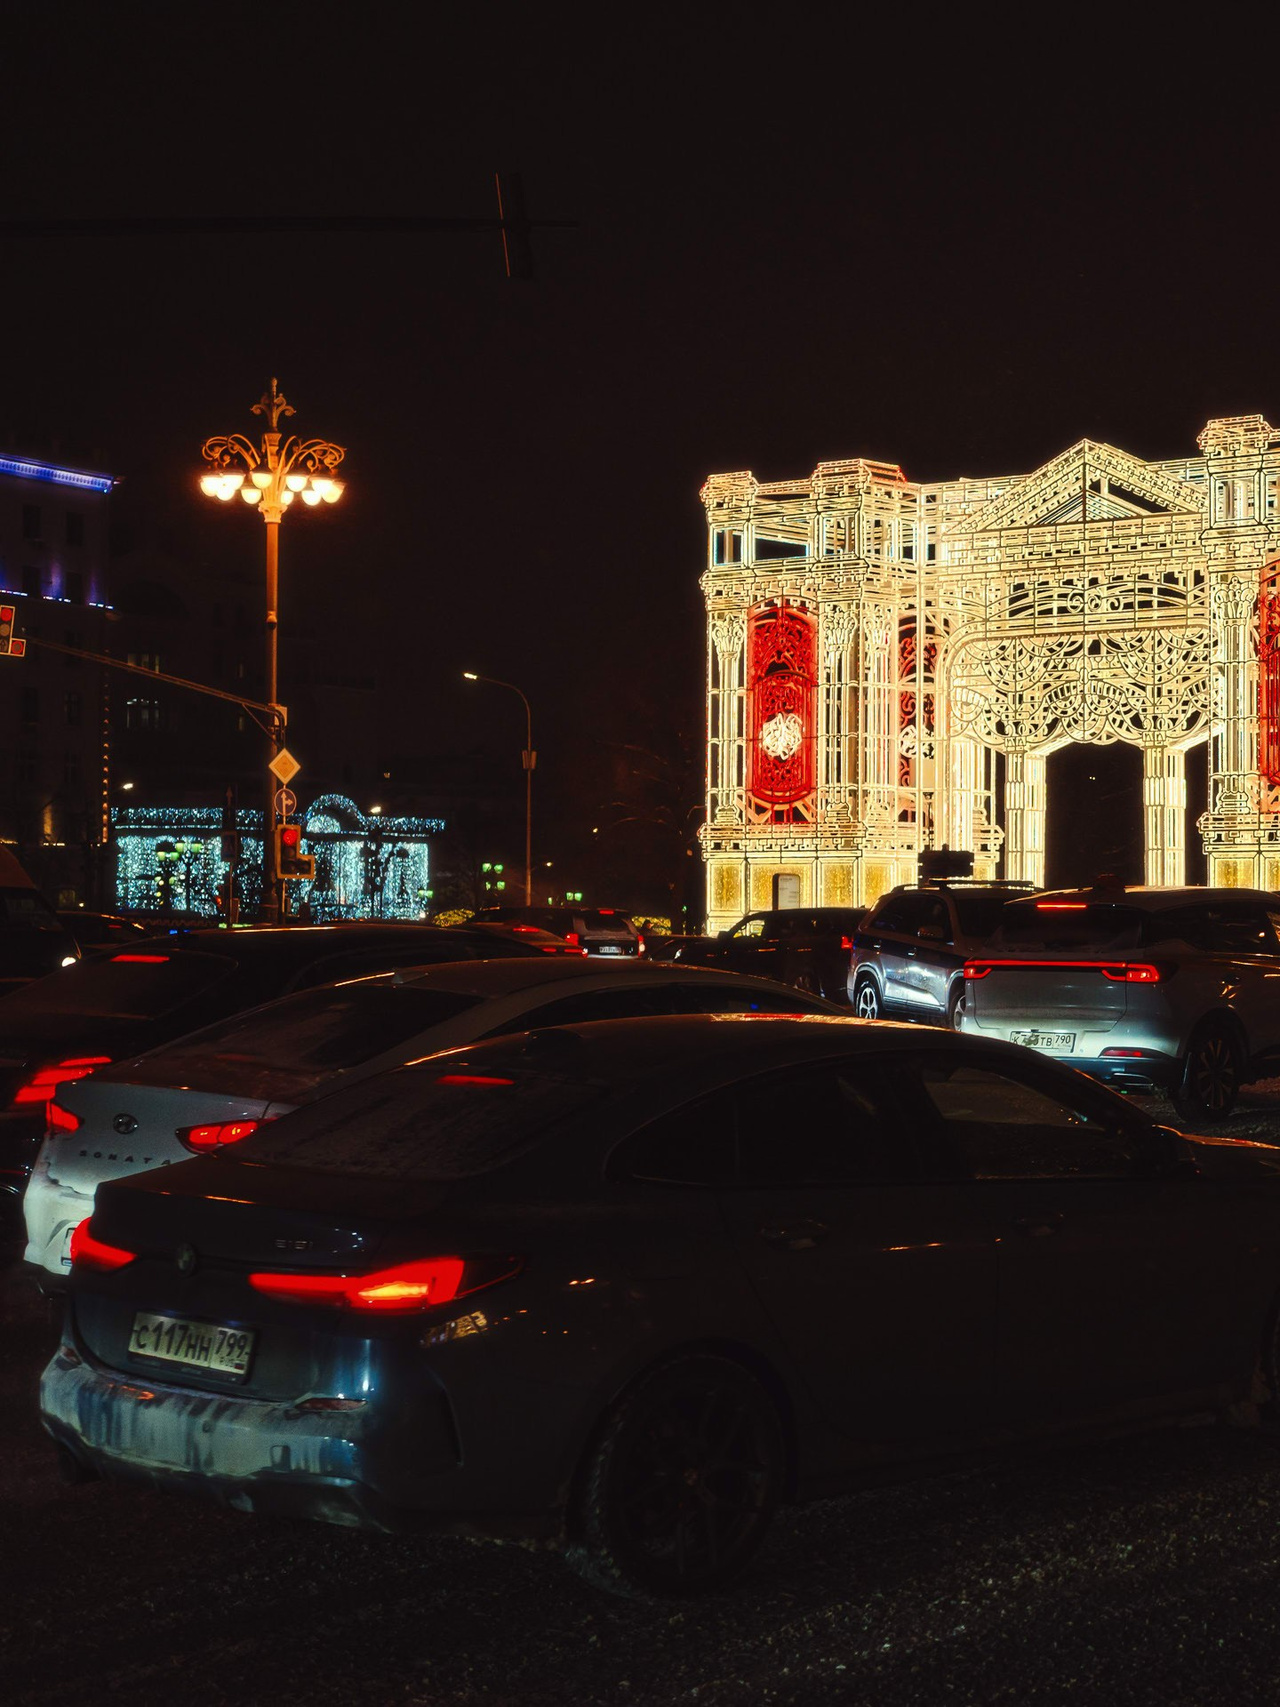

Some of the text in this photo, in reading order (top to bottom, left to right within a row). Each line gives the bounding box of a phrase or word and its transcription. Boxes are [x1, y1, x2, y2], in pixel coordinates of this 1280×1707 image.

[1055, 1035, 1071, 1044] 790
[79, 1150, 172, 1165] SONATA
[216, 1330, 248, 1358] 799
